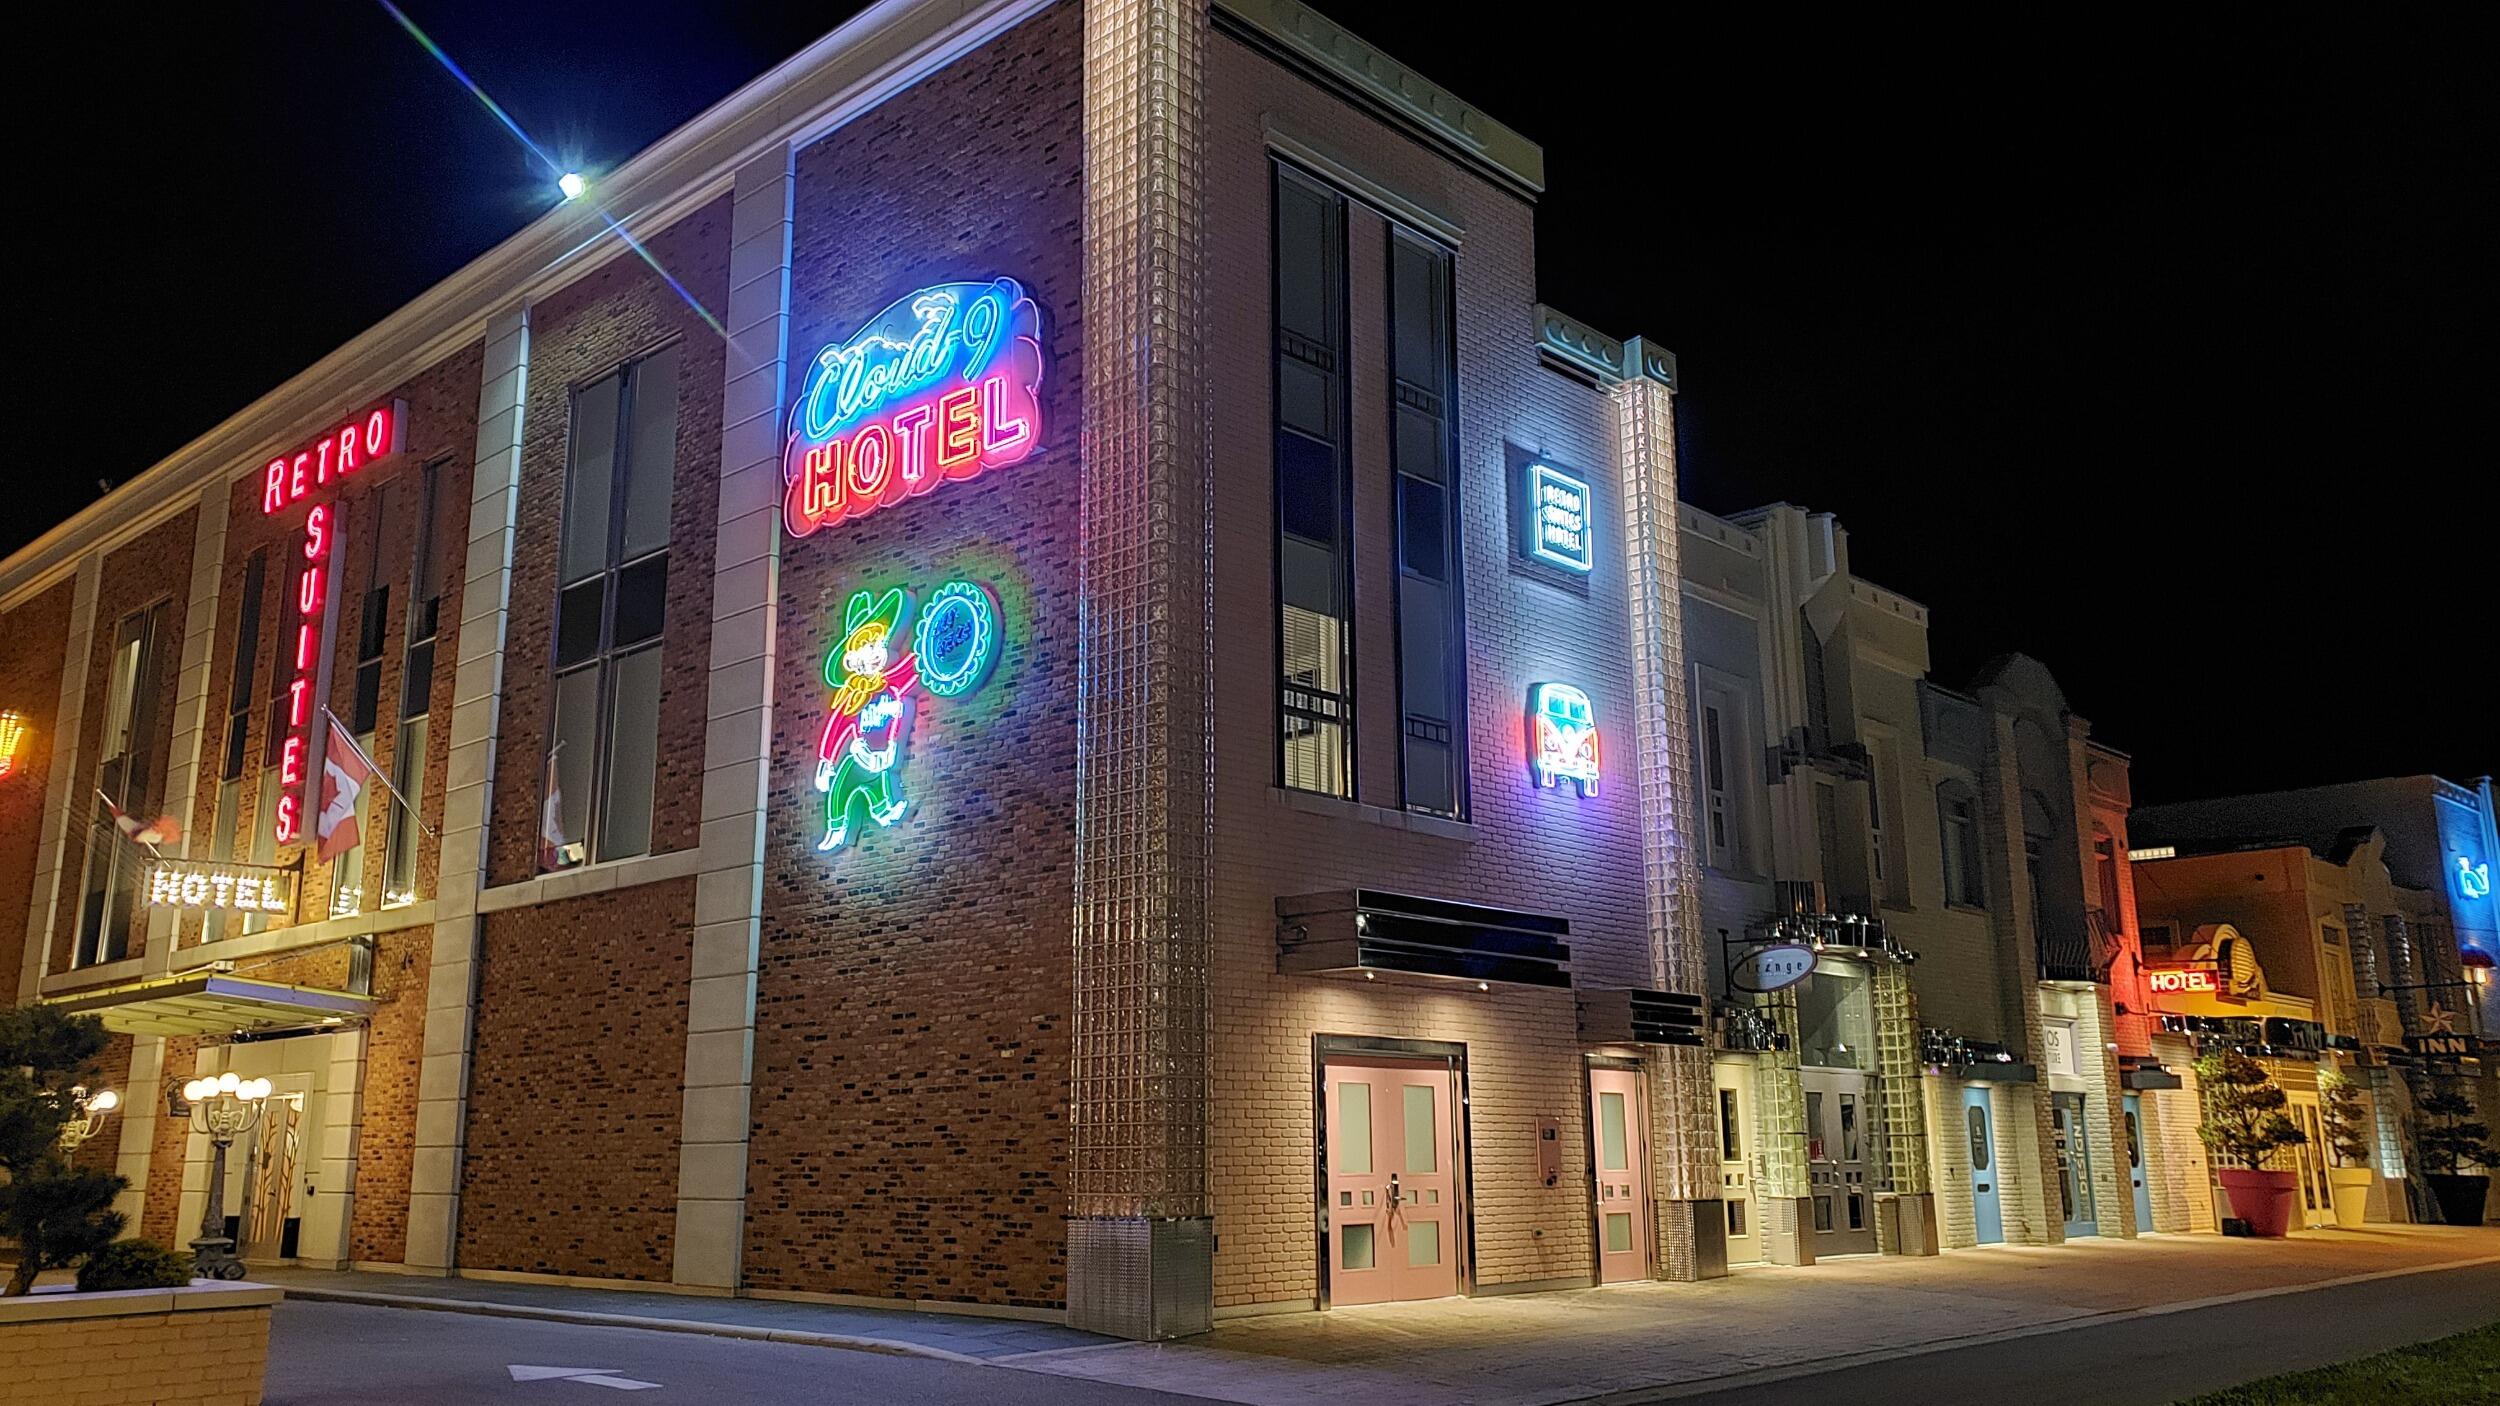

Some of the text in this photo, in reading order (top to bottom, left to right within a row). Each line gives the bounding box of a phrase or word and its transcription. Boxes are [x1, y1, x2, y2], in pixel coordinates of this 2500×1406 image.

[806, 295, 999, 438] Cloud 9
[262, 408, 385, 514] RETRO
[803, 376, 1030, 516] HOTEL
[275, 504, 324, 845] SUITES
[150, 867, 287, 911] HOTEL
[2150, 972, 2216, 992] HOTEL
[2418, 1037, 2467, 1054] INN
[2073, 1125, 2088, 1194] DESIGN
